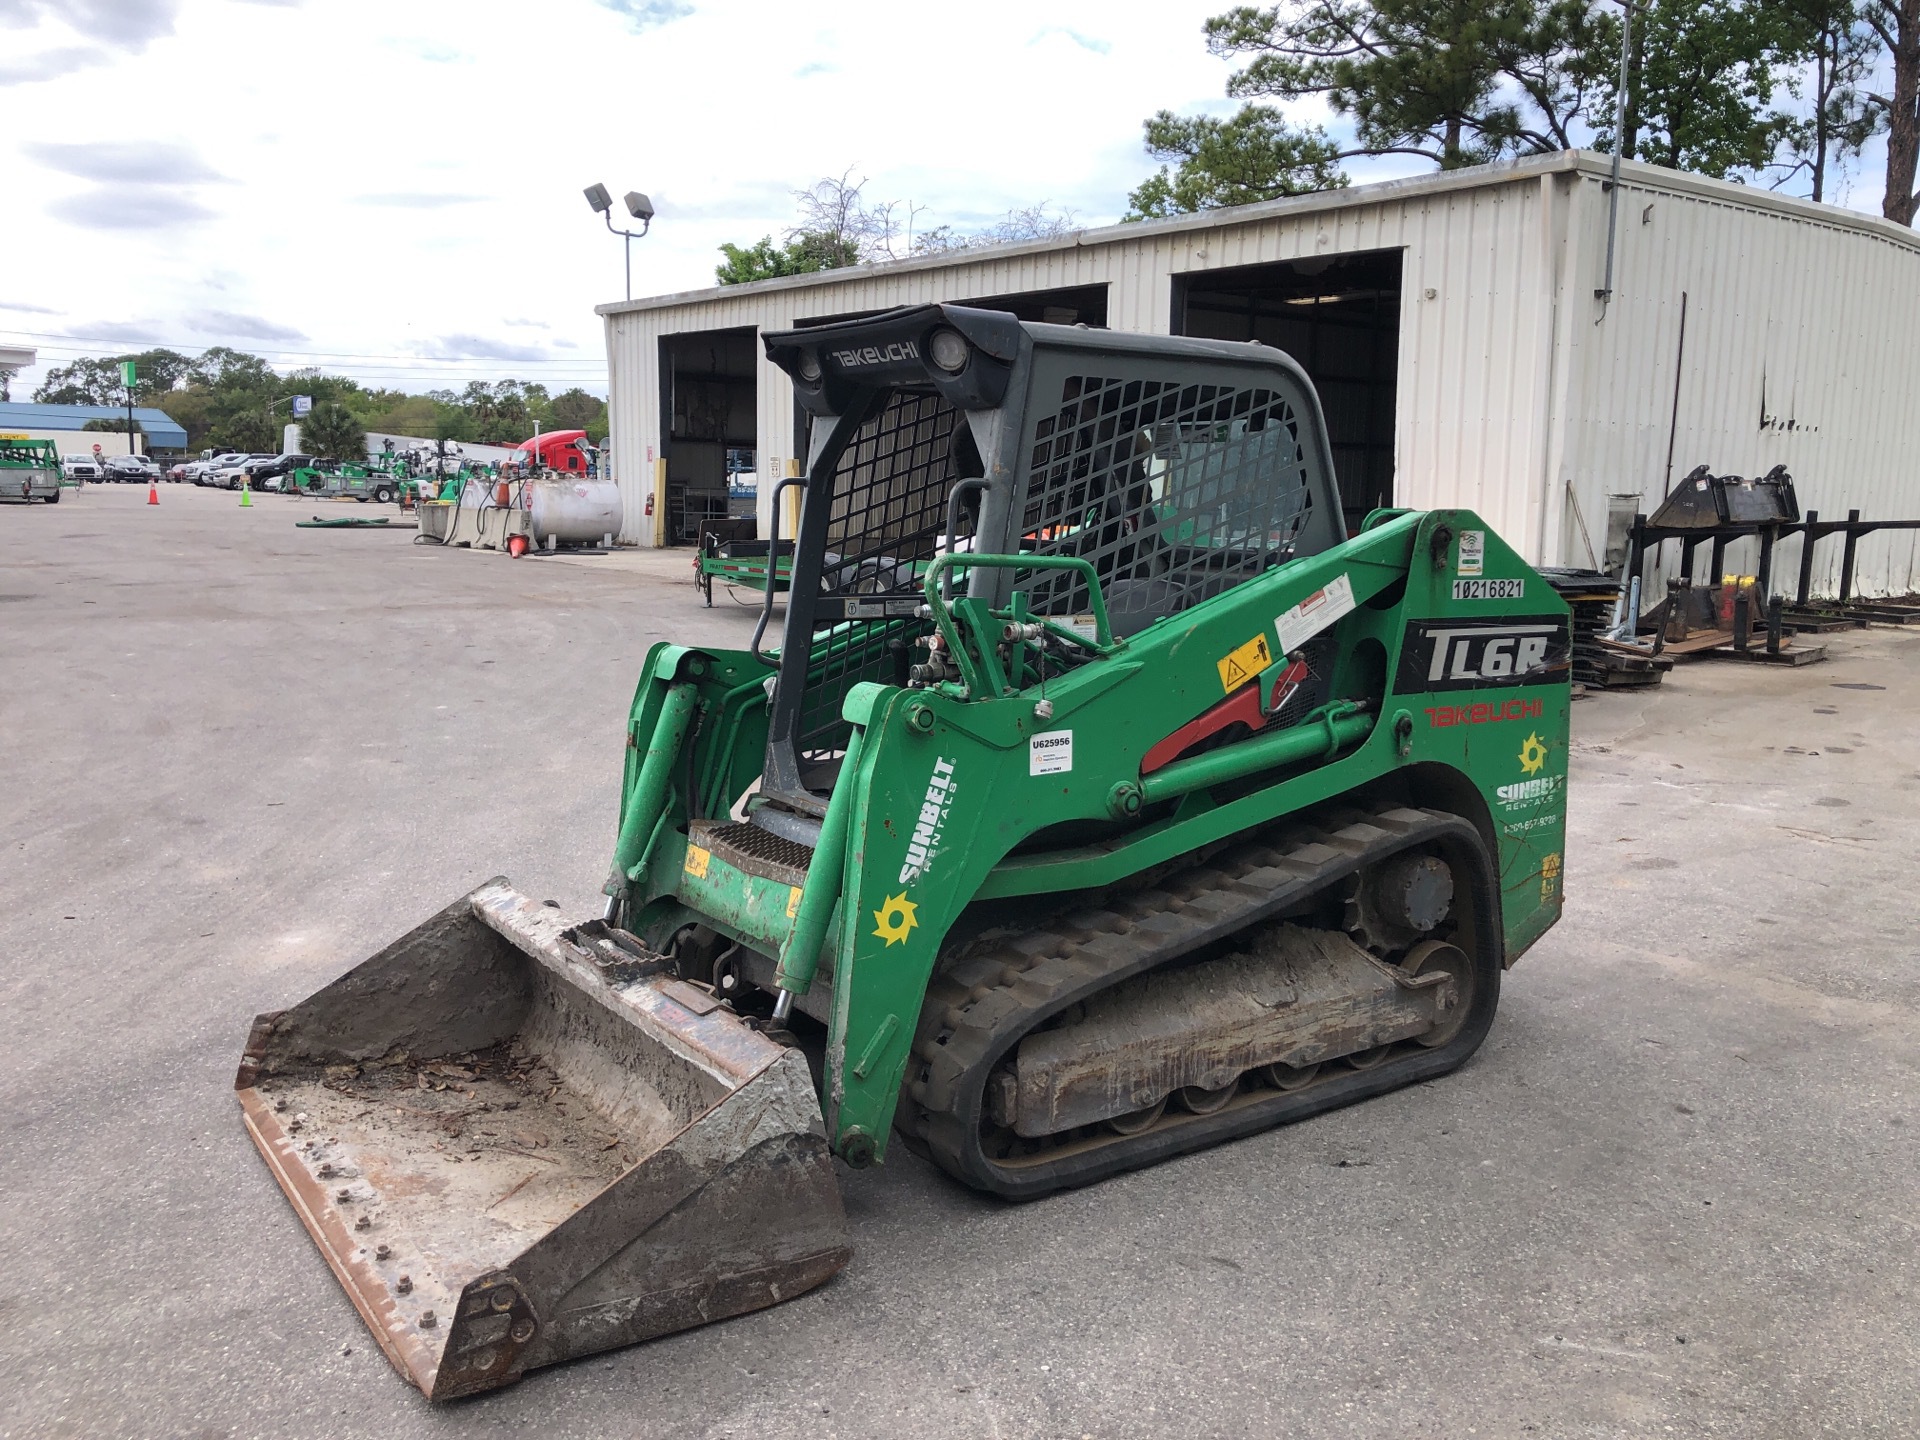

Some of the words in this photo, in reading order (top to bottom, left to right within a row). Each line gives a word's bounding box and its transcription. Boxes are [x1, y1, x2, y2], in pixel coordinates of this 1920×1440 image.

[832, 341, 919, 367] TAKEUCHI
[1454, 580, 1522, 599] 10216821
[1426, 624, 1559, 682] TL6R
[1424, 698, 1543, 728] TAKEUCHI
[1032, 737, 1070, 750] U625956
[1496, 774, 1565, 805] SUNBELT
[898, 756, 955, 888] SUNBELT
[923, 782, 958, 873] RENTALS
